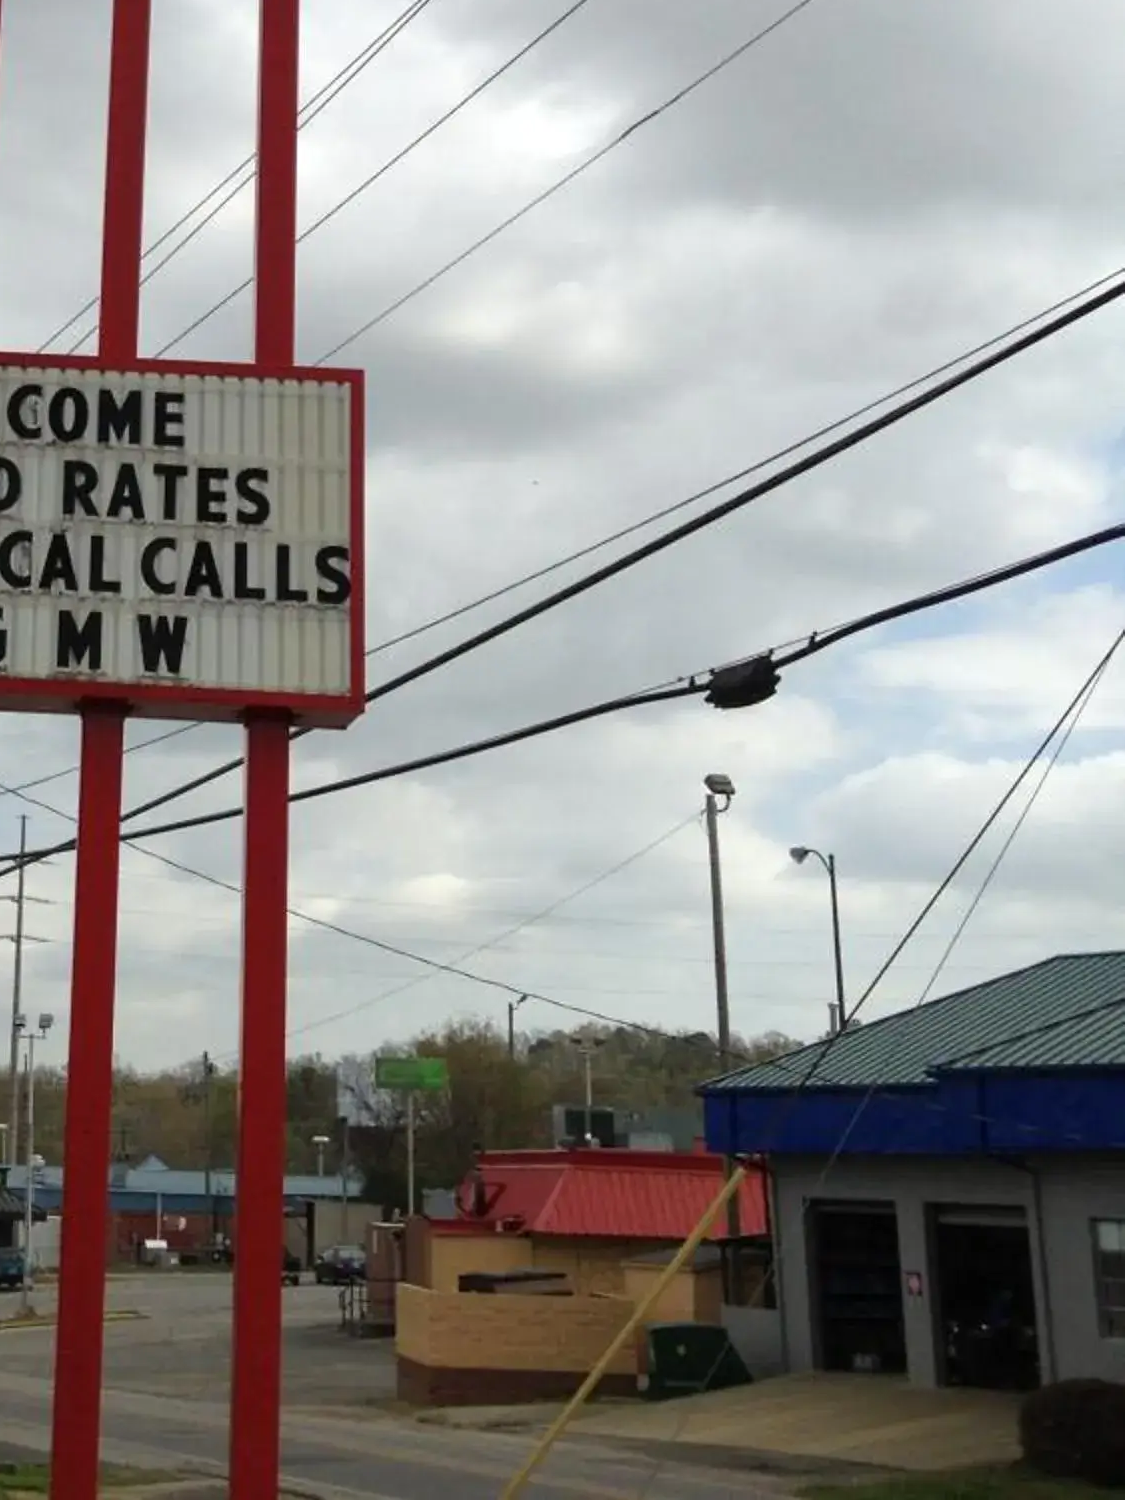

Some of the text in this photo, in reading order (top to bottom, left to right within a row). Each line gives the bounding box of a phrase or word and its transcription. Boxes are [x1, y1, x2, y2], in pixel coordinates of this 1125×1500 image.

[62, 460, 271, 526] RATES
[140, 536, 353, 606] CALLS
[56, 609, 103, 673] M
[136, 613, 188, 676] W
